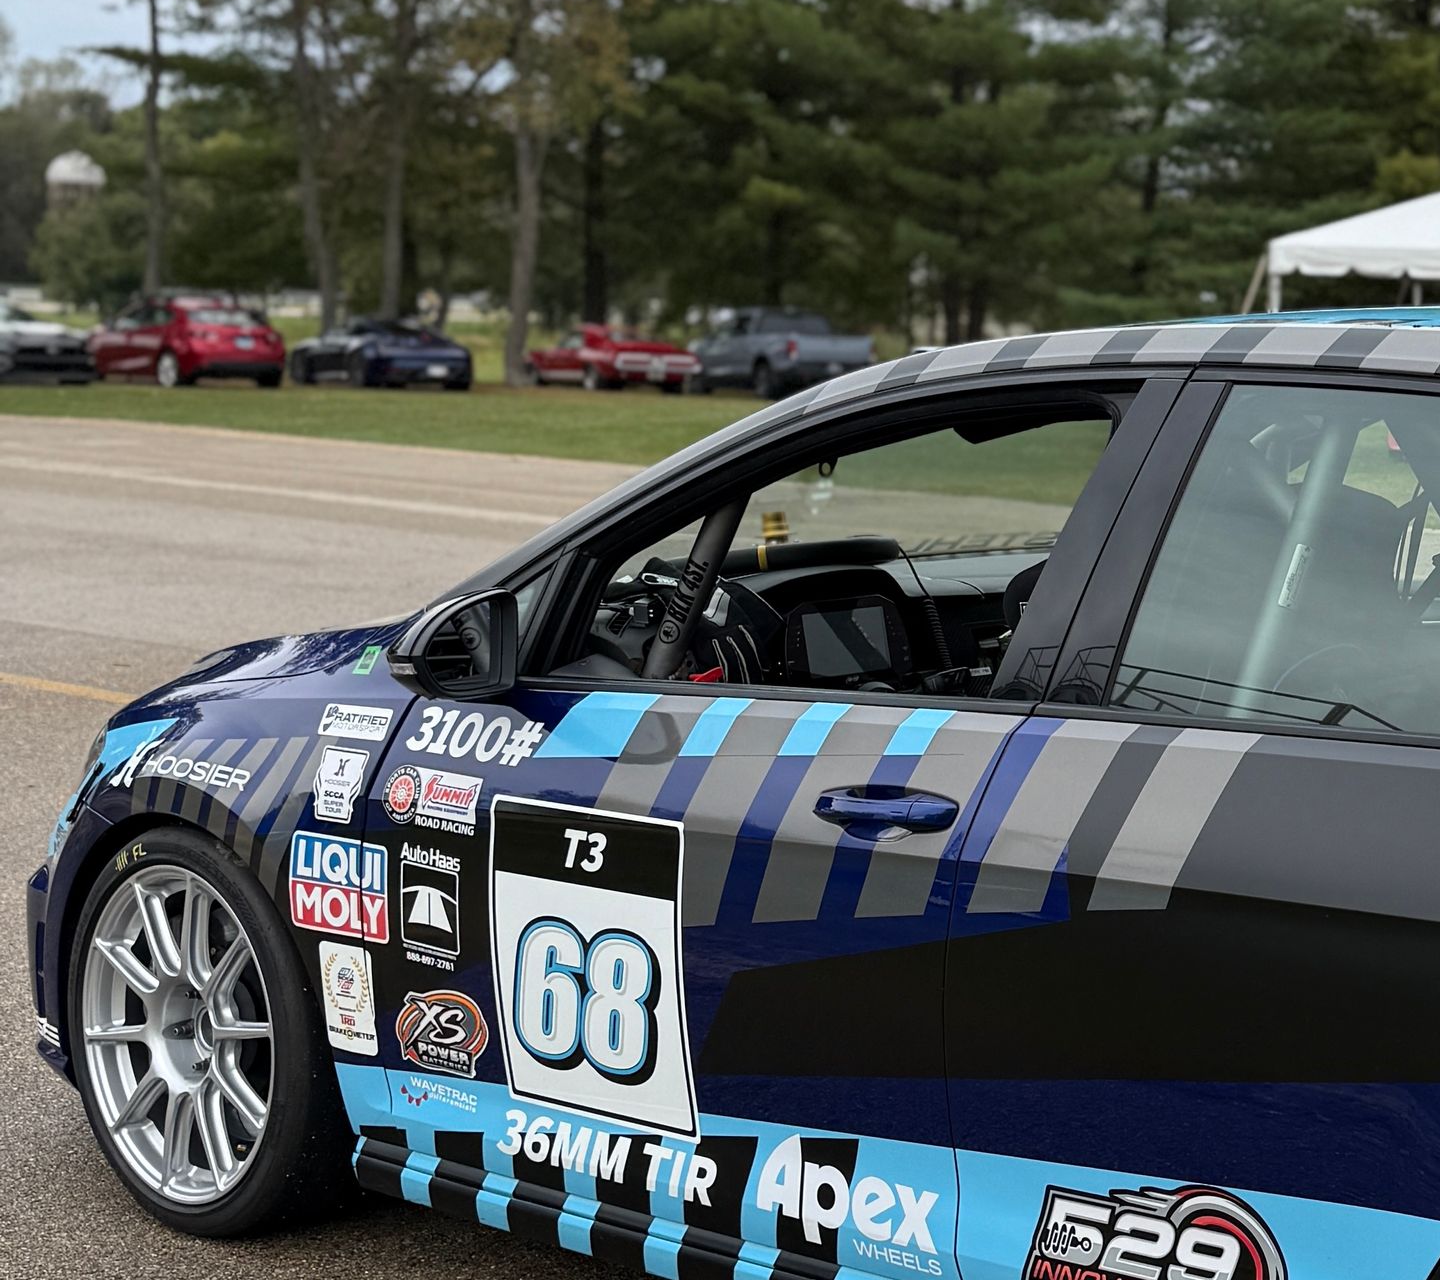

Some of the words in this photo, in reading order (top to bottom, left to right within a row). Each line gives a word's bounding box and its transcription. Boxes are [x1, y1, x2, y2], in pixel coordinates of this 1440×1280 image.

[405, 706, 545, 767] 3100#
[142, 754, 251, 792] HOOSIER
[323, 790, 345, 800] SCCA
[323, 799, 344, 808] SUPER
[324, 806, 342, 814] TOUR
[422, 774, 480, 811] SUMMIT
[414, 814, 440, 830] ROAD
[440, 819, 475, 837] RACING
[296, 838, 382, 891] LIQUI
[562, 828, 608, 872] T3
[295, 883, 385, 935] MOLY
[513, 915, 661, 1087] 68
[405, 998, 468, 1049] XS
[417, 1041, 470, 1065] POWER
[421, 1055, 470, 1073] BATTERIES
[410, 1076, 479, 1106] WAVETRAC
[496, 1109, 632, 1184] 36MM
[642, 1141, 719, 1207] TIR
[756, 1133, 941, 1256] Apex
[852, 1240, 943, 1277] WHEELS
